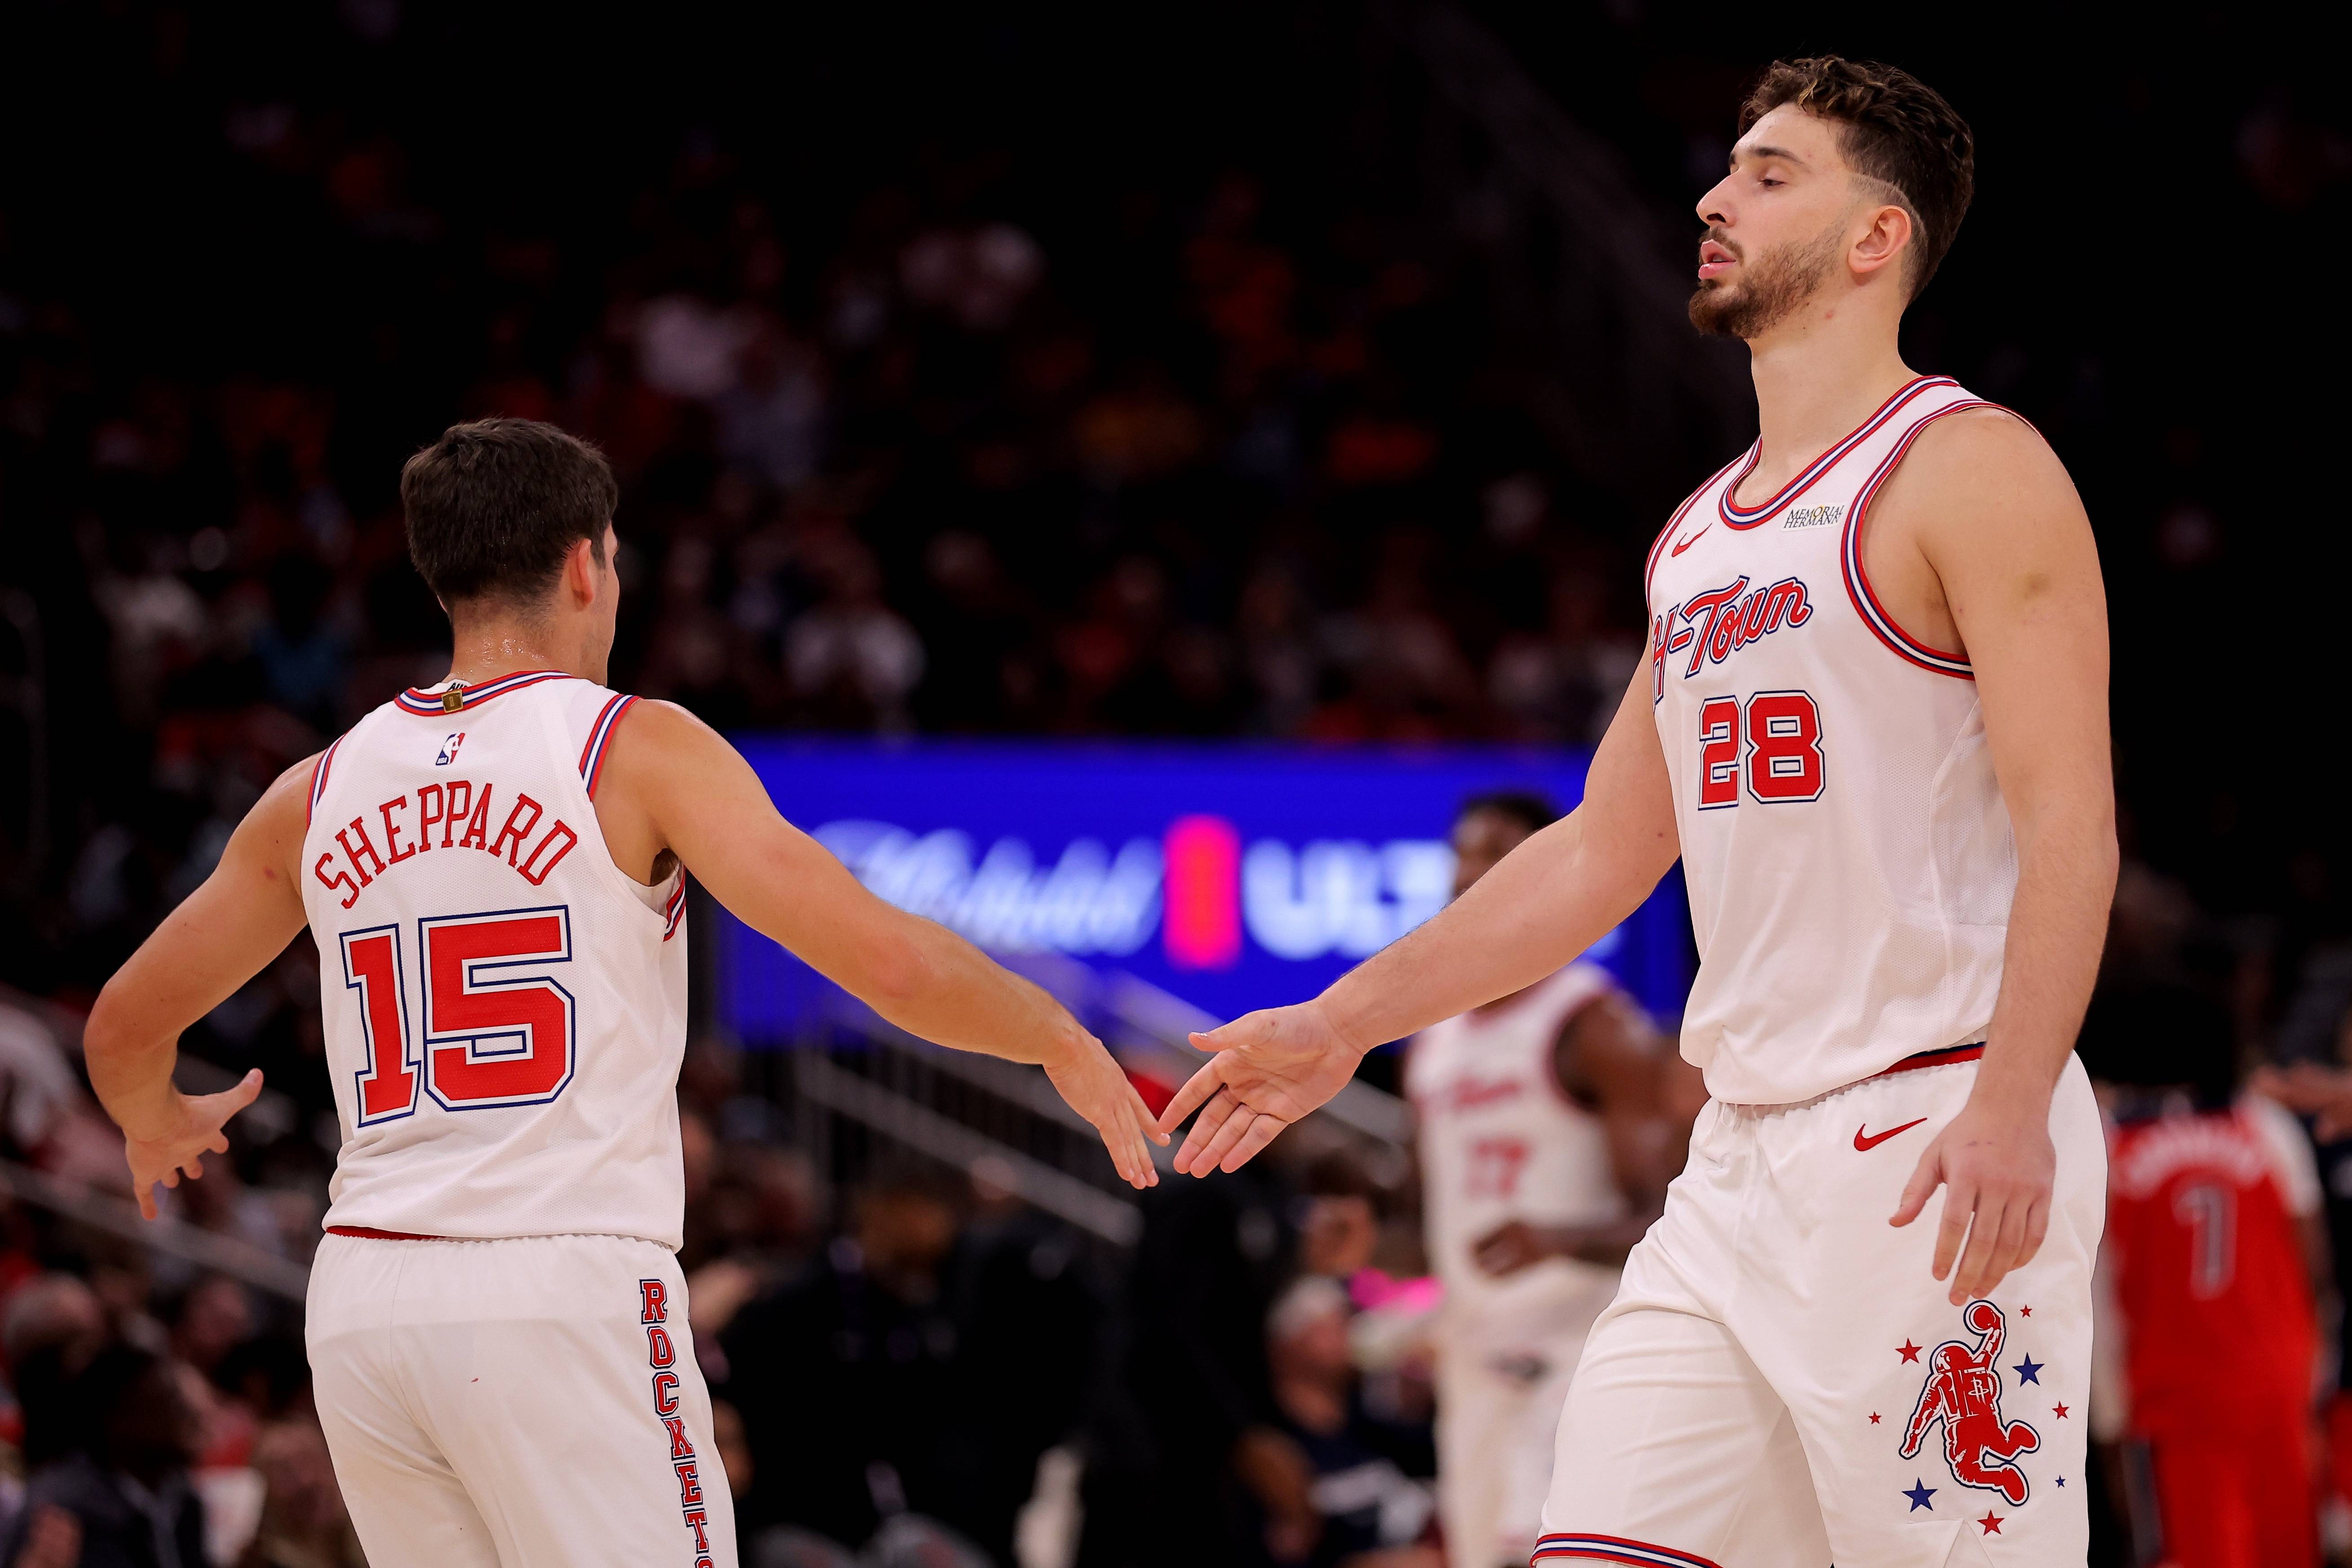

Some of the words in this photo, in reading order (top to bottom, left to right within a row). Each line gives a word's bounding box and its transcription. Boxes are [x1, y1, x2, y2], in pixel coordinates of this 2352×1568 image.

[1783, 514, 1841, 529] HERMANN
[1787, 505, 1845, 520] MEMORIAL
[1652, 575, 1813, 705] H-Town
[1698, 690, 1826, 811] 28
[315, 780, 578, 909] SHEPPARD
[339, 905, 575, 1128] 15
[640, 1279, 715, 1568] ROCKET
